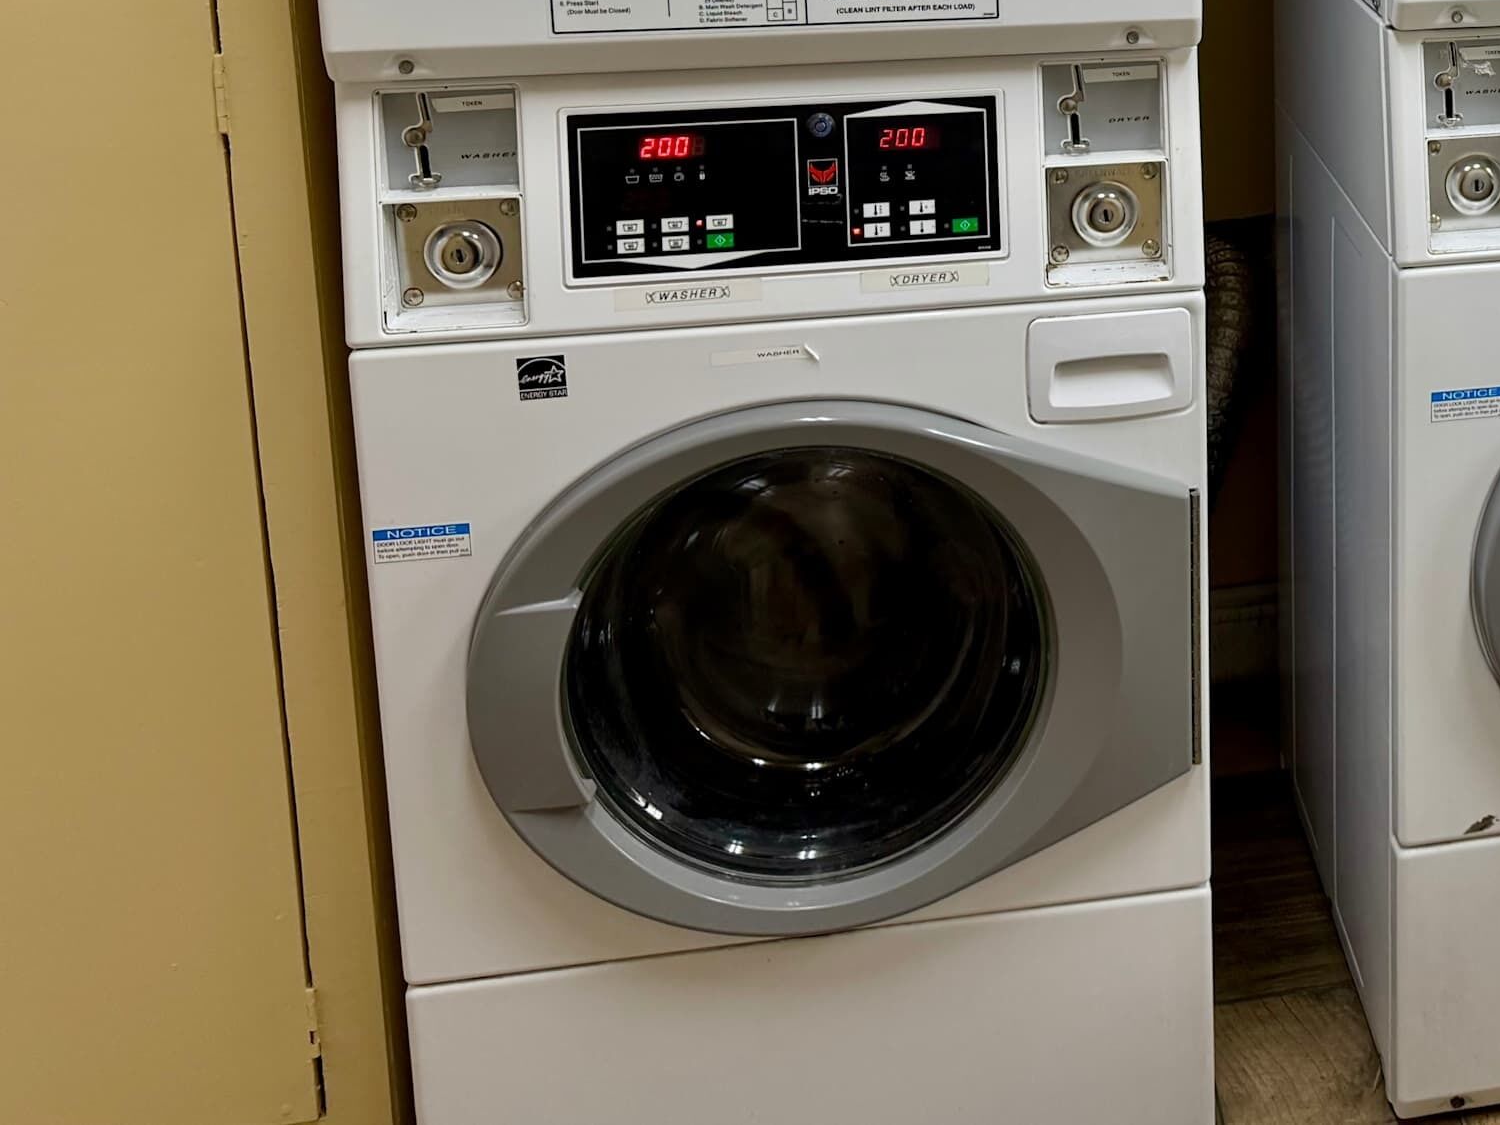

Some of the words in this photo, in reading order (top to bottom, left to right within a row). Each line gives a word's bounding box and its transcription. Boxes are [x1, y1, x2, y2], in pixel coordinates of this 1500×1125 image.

[836, 7, 863, 15] (CLEAN
[953, 3, 975, 11] LOAD)
[1108, 115, 1150, 123] DRYER
[880, 127, 925, 148] 200
[640, 136, 689, 158] 200
[808, 186, 838, 196] IPSO
[902, 273, 946, 284] DRYER
[659, 288, 717, 301] WASHER
[757, 349, 799, 358] WASHER
[520, 390, 548, 400] ENERGY
[549, 389, 568, 398] STAR
[1442, 389, 1497, 400] NOTICE
[387, 525, 457, 539] NOTICE
